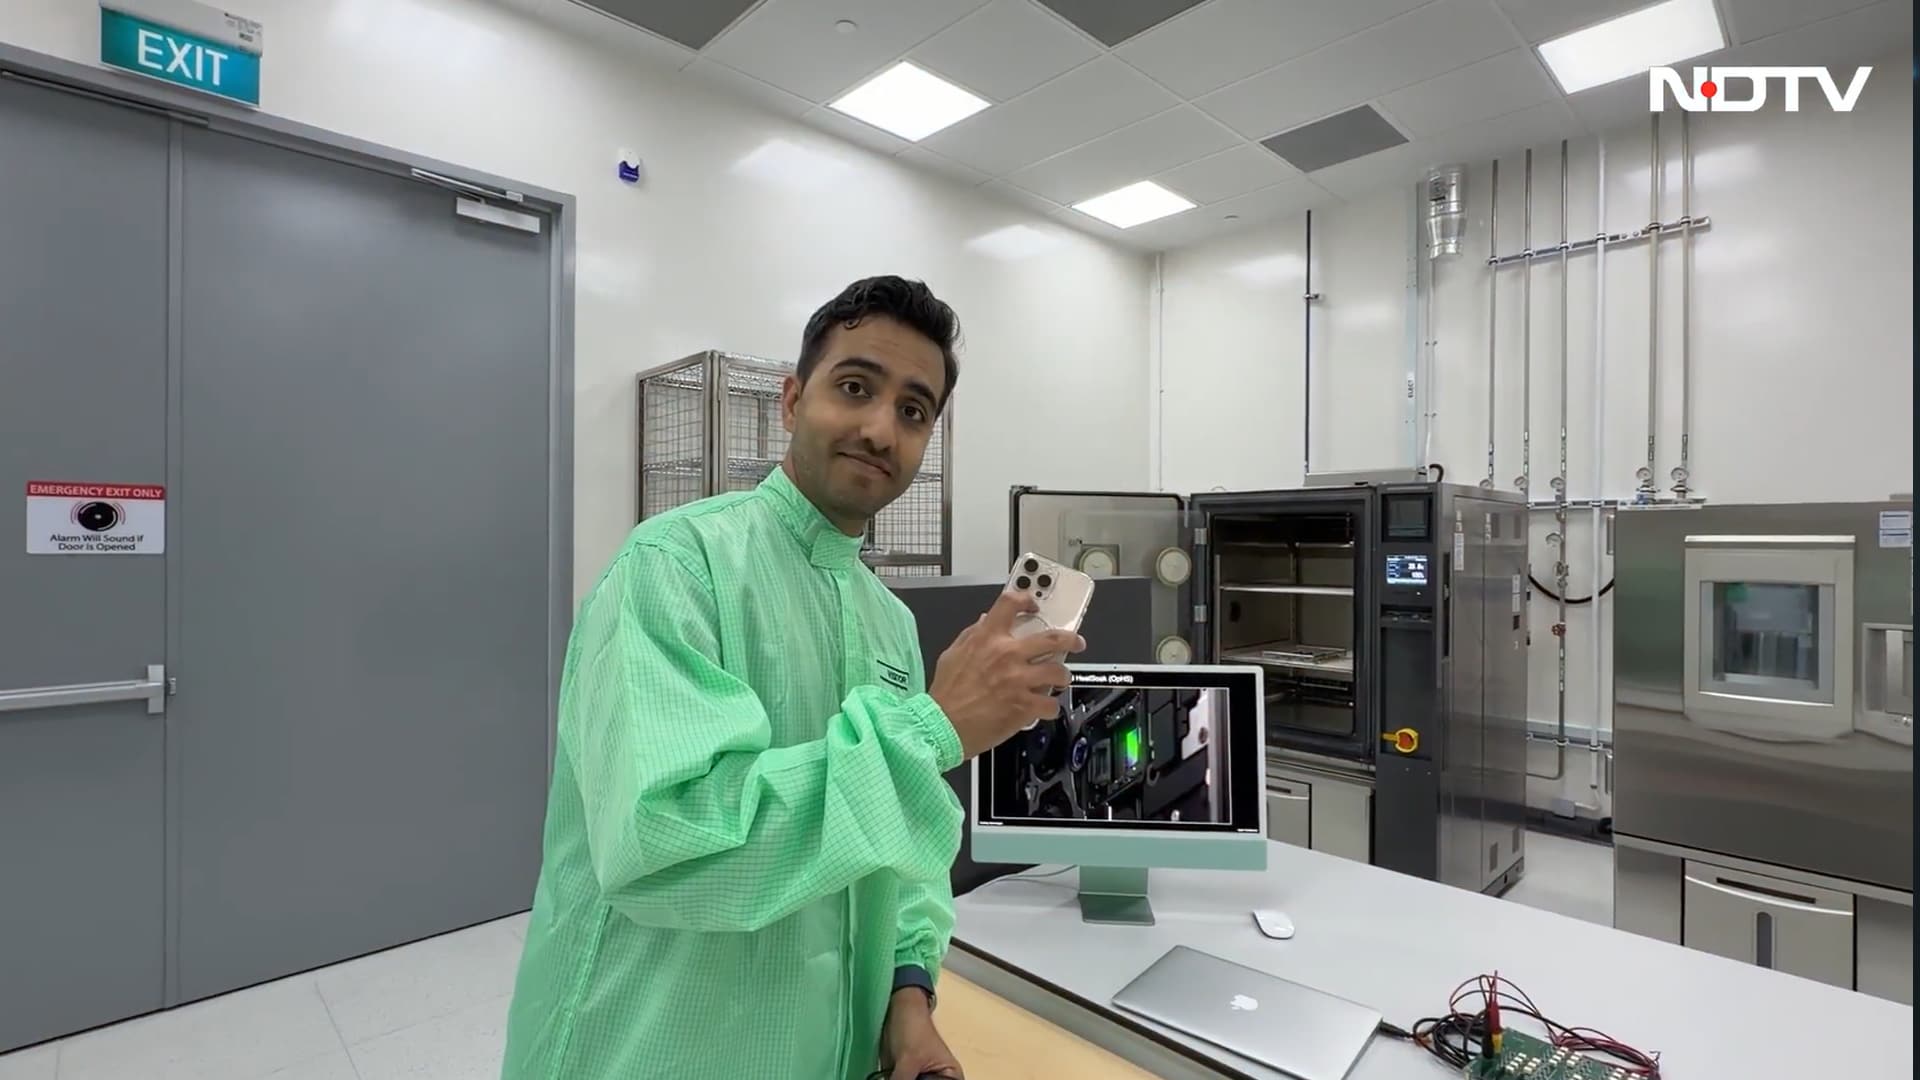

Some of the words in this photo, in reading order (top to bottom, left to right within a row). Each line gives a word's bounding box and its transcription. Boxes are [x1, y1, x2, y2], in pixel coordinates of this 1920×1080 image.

[137, 28, 229, 86] EXIT
[29, 484, 104, 496] EMERGENCY
[105, 486, 131, 497] EXIT
[132, 487, 163, 498] ONLY
[49, 534, 81, 543] Alarm
[81, 534, 101, 543] Will
[102, 534, 135, 543] Sound
[136, 534, 144, 543] if
[57, 543, 84, 551] Door
[95, 543, 136, 552] Opened
